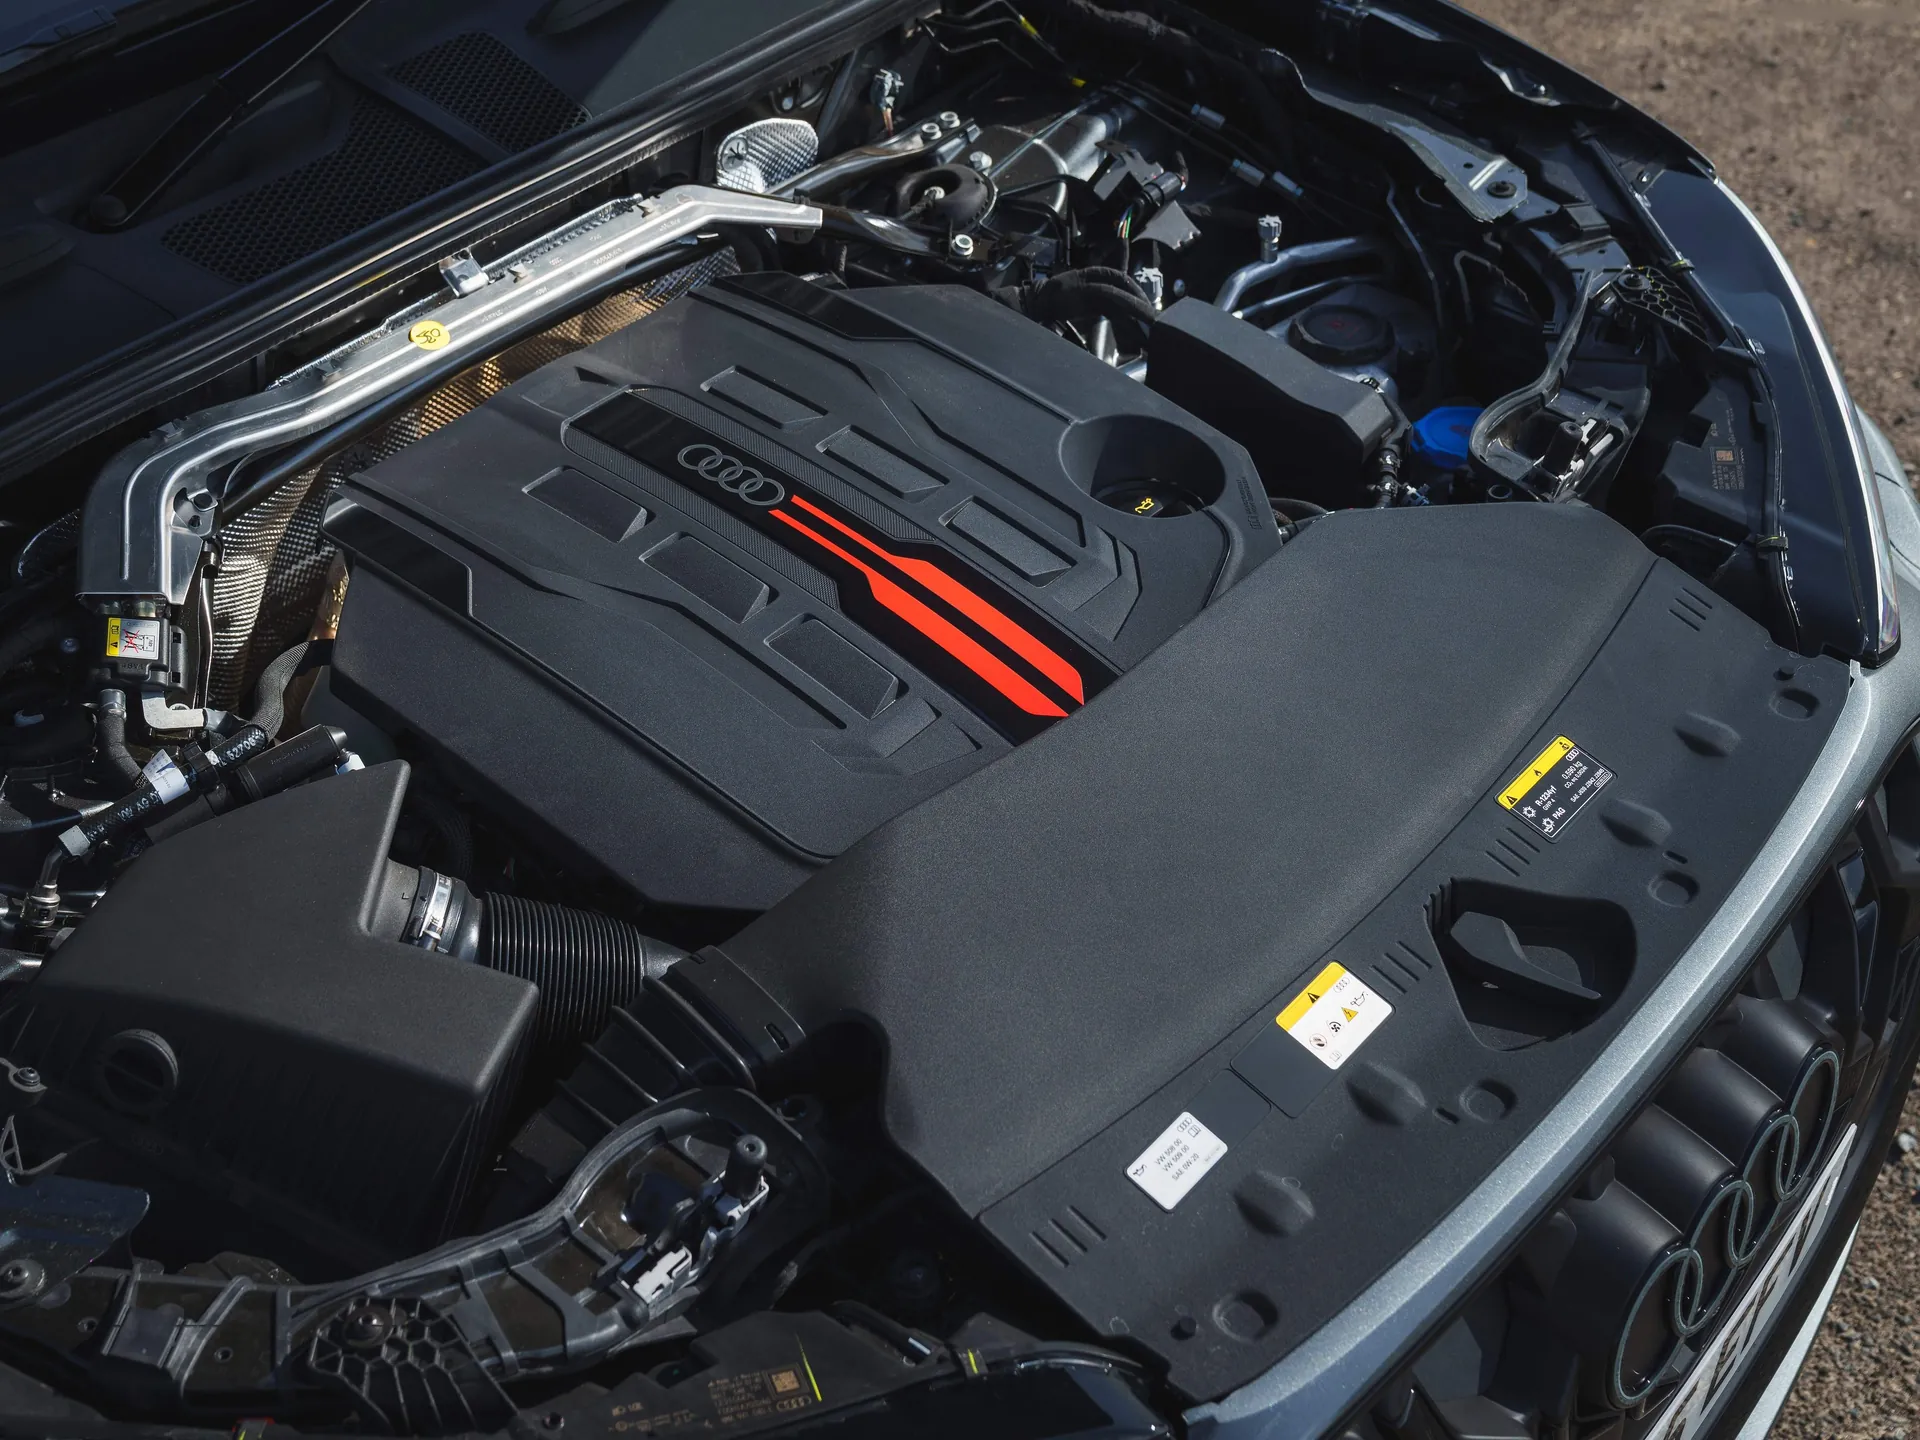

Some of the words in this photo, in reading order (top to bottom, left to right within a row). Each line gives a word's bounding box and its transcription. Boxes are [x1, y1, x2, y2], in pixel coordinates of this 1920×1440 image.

[1535, 785, 1557, 806] R-1234yf
[1552, 807, 1566, 819] PAG
[1154, 1153, 1166, 1165] VW
[1174, 1138, 1183, 1147] 00
[1163, 1160, 1173, 1172] VW
[1181, 1144, 1190, 1153] 00
[1172, 1168, 1184, 1181] SAE
